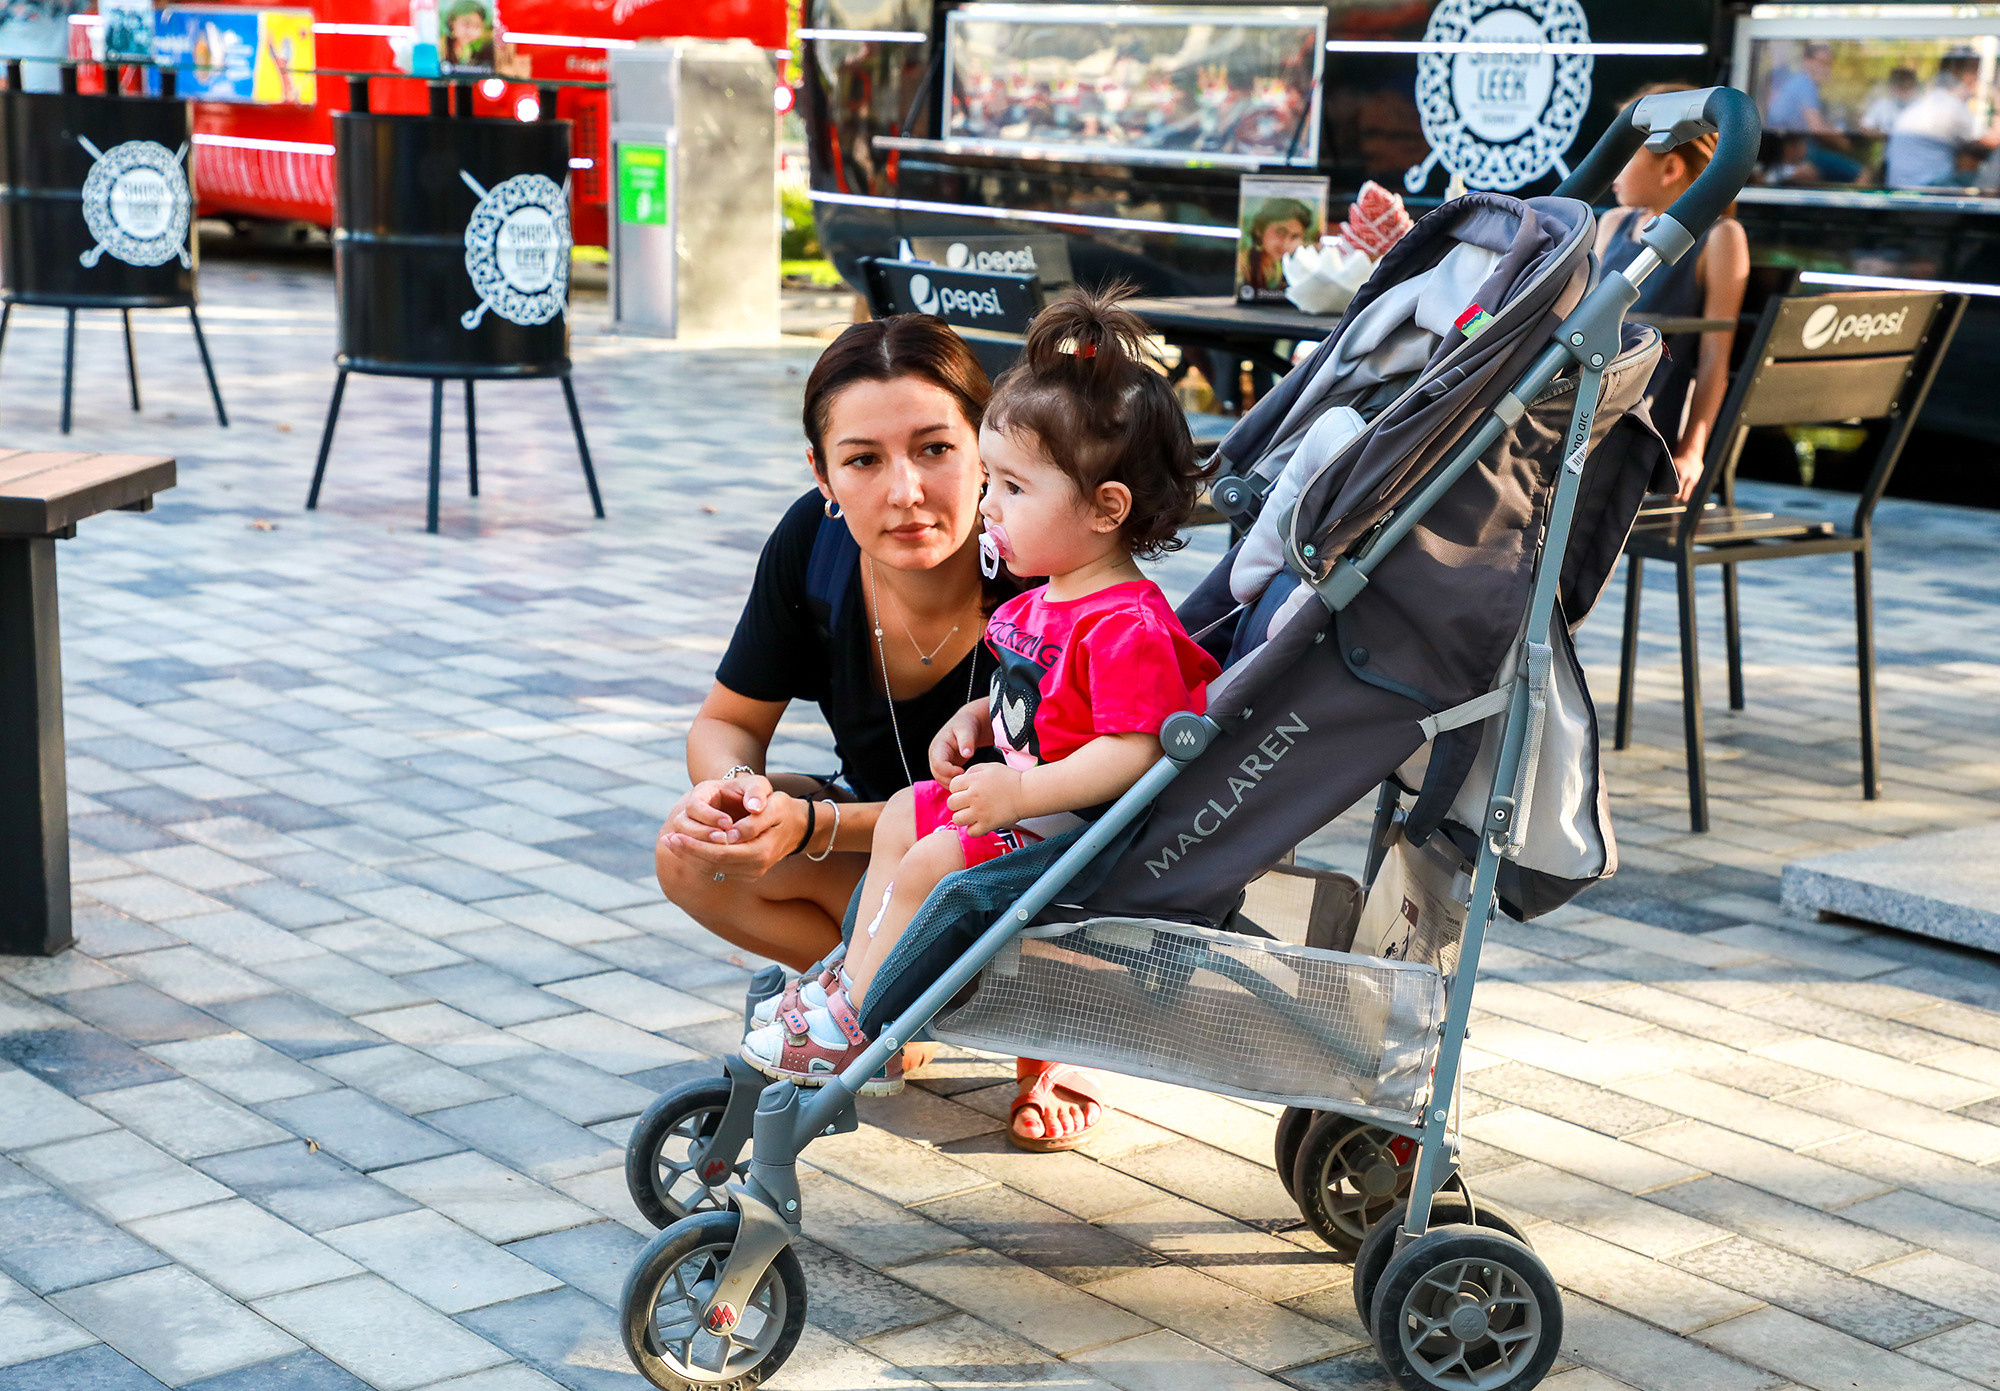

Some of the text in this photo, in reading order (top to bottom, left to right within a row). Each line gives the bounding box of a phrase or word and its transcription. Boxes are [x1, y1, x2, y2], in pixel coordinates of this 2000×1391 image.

[1477, 68, 1529, 101] LEEK
[976, 245, 1035, 274] pepsi
[940, 287, 1003, 319] pepsi
[1832, 305, 1910, 345] pepsi
[1578, 411, 1590, 431] arc
[1144, 711, 1310, 879] MACLAREN
